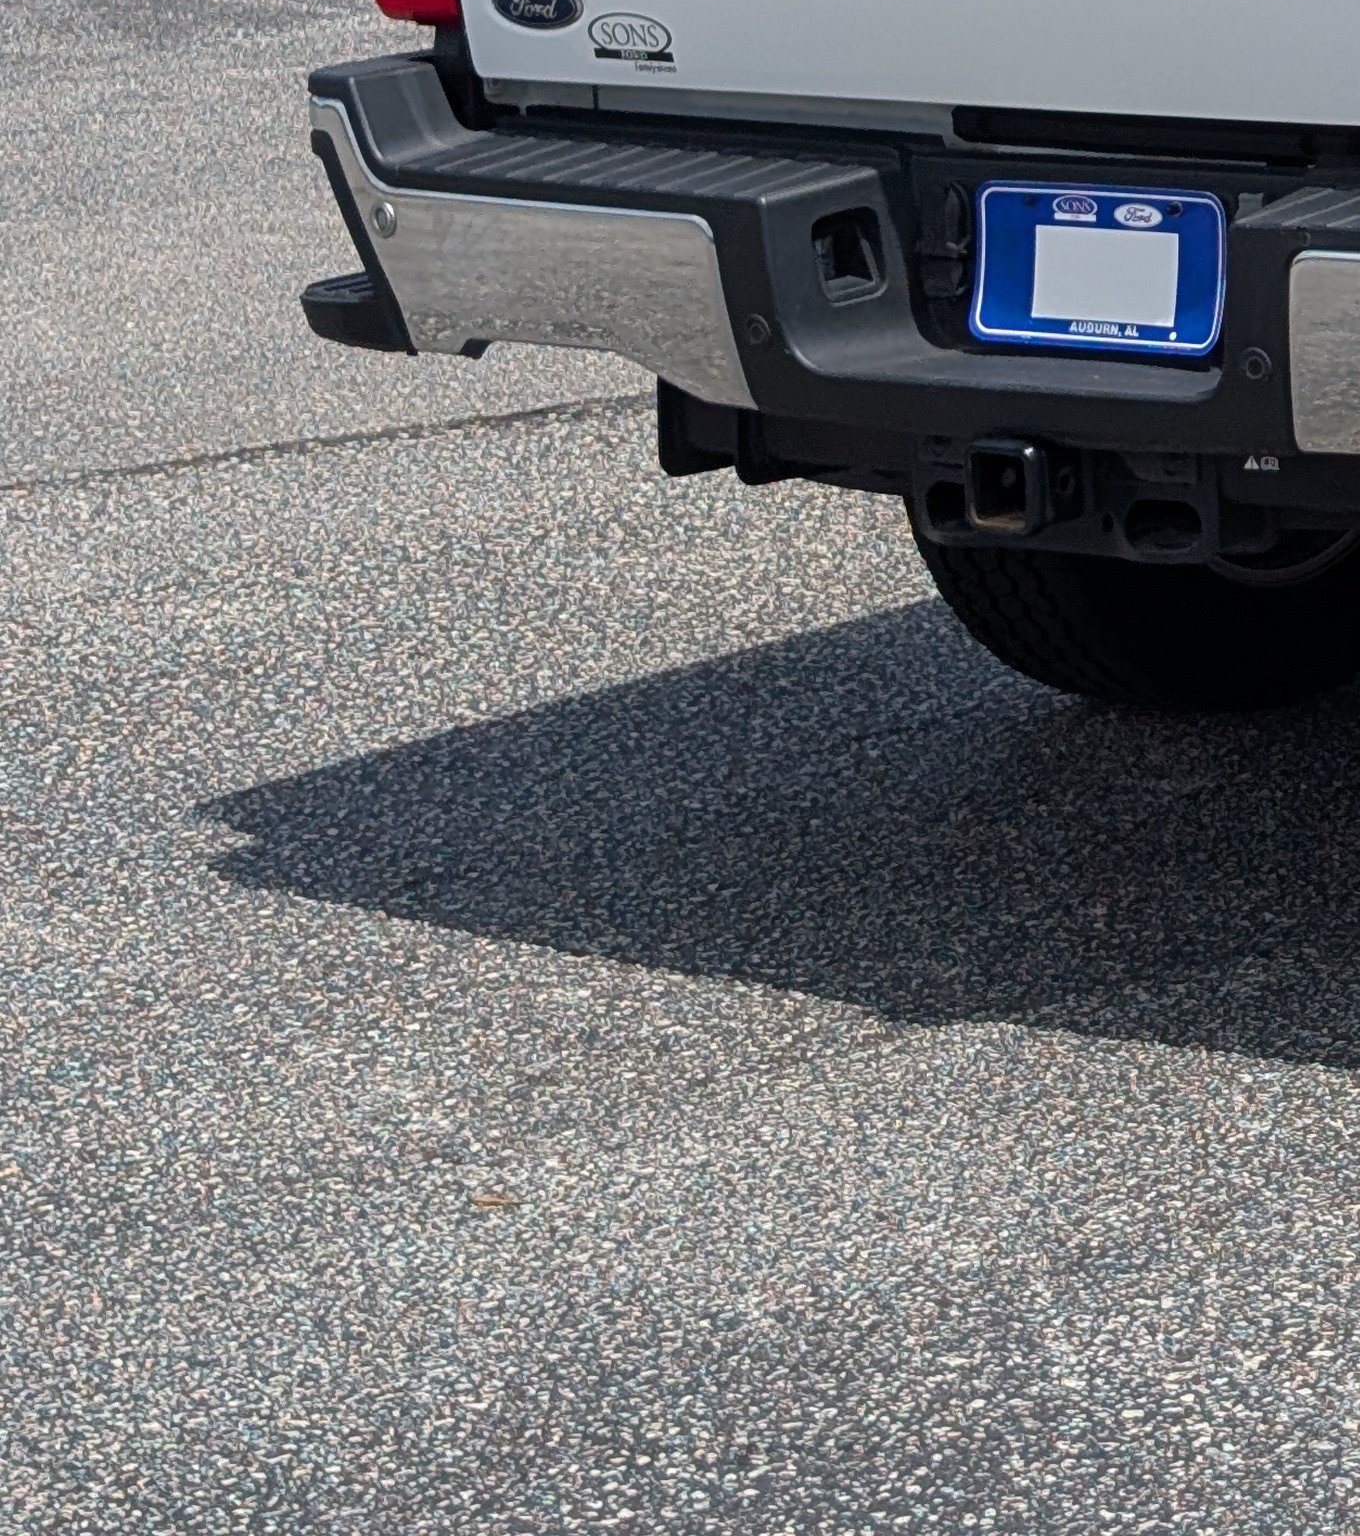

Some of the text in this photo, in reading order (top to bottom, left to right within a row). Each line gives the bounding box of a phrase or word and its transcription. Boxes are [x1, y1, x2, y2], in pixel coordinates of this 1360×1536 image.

[600, 21, 660, 49] SONS
[1123, 206, 1154, 224] Ford
[1124, 324, 1139, 337] AL
